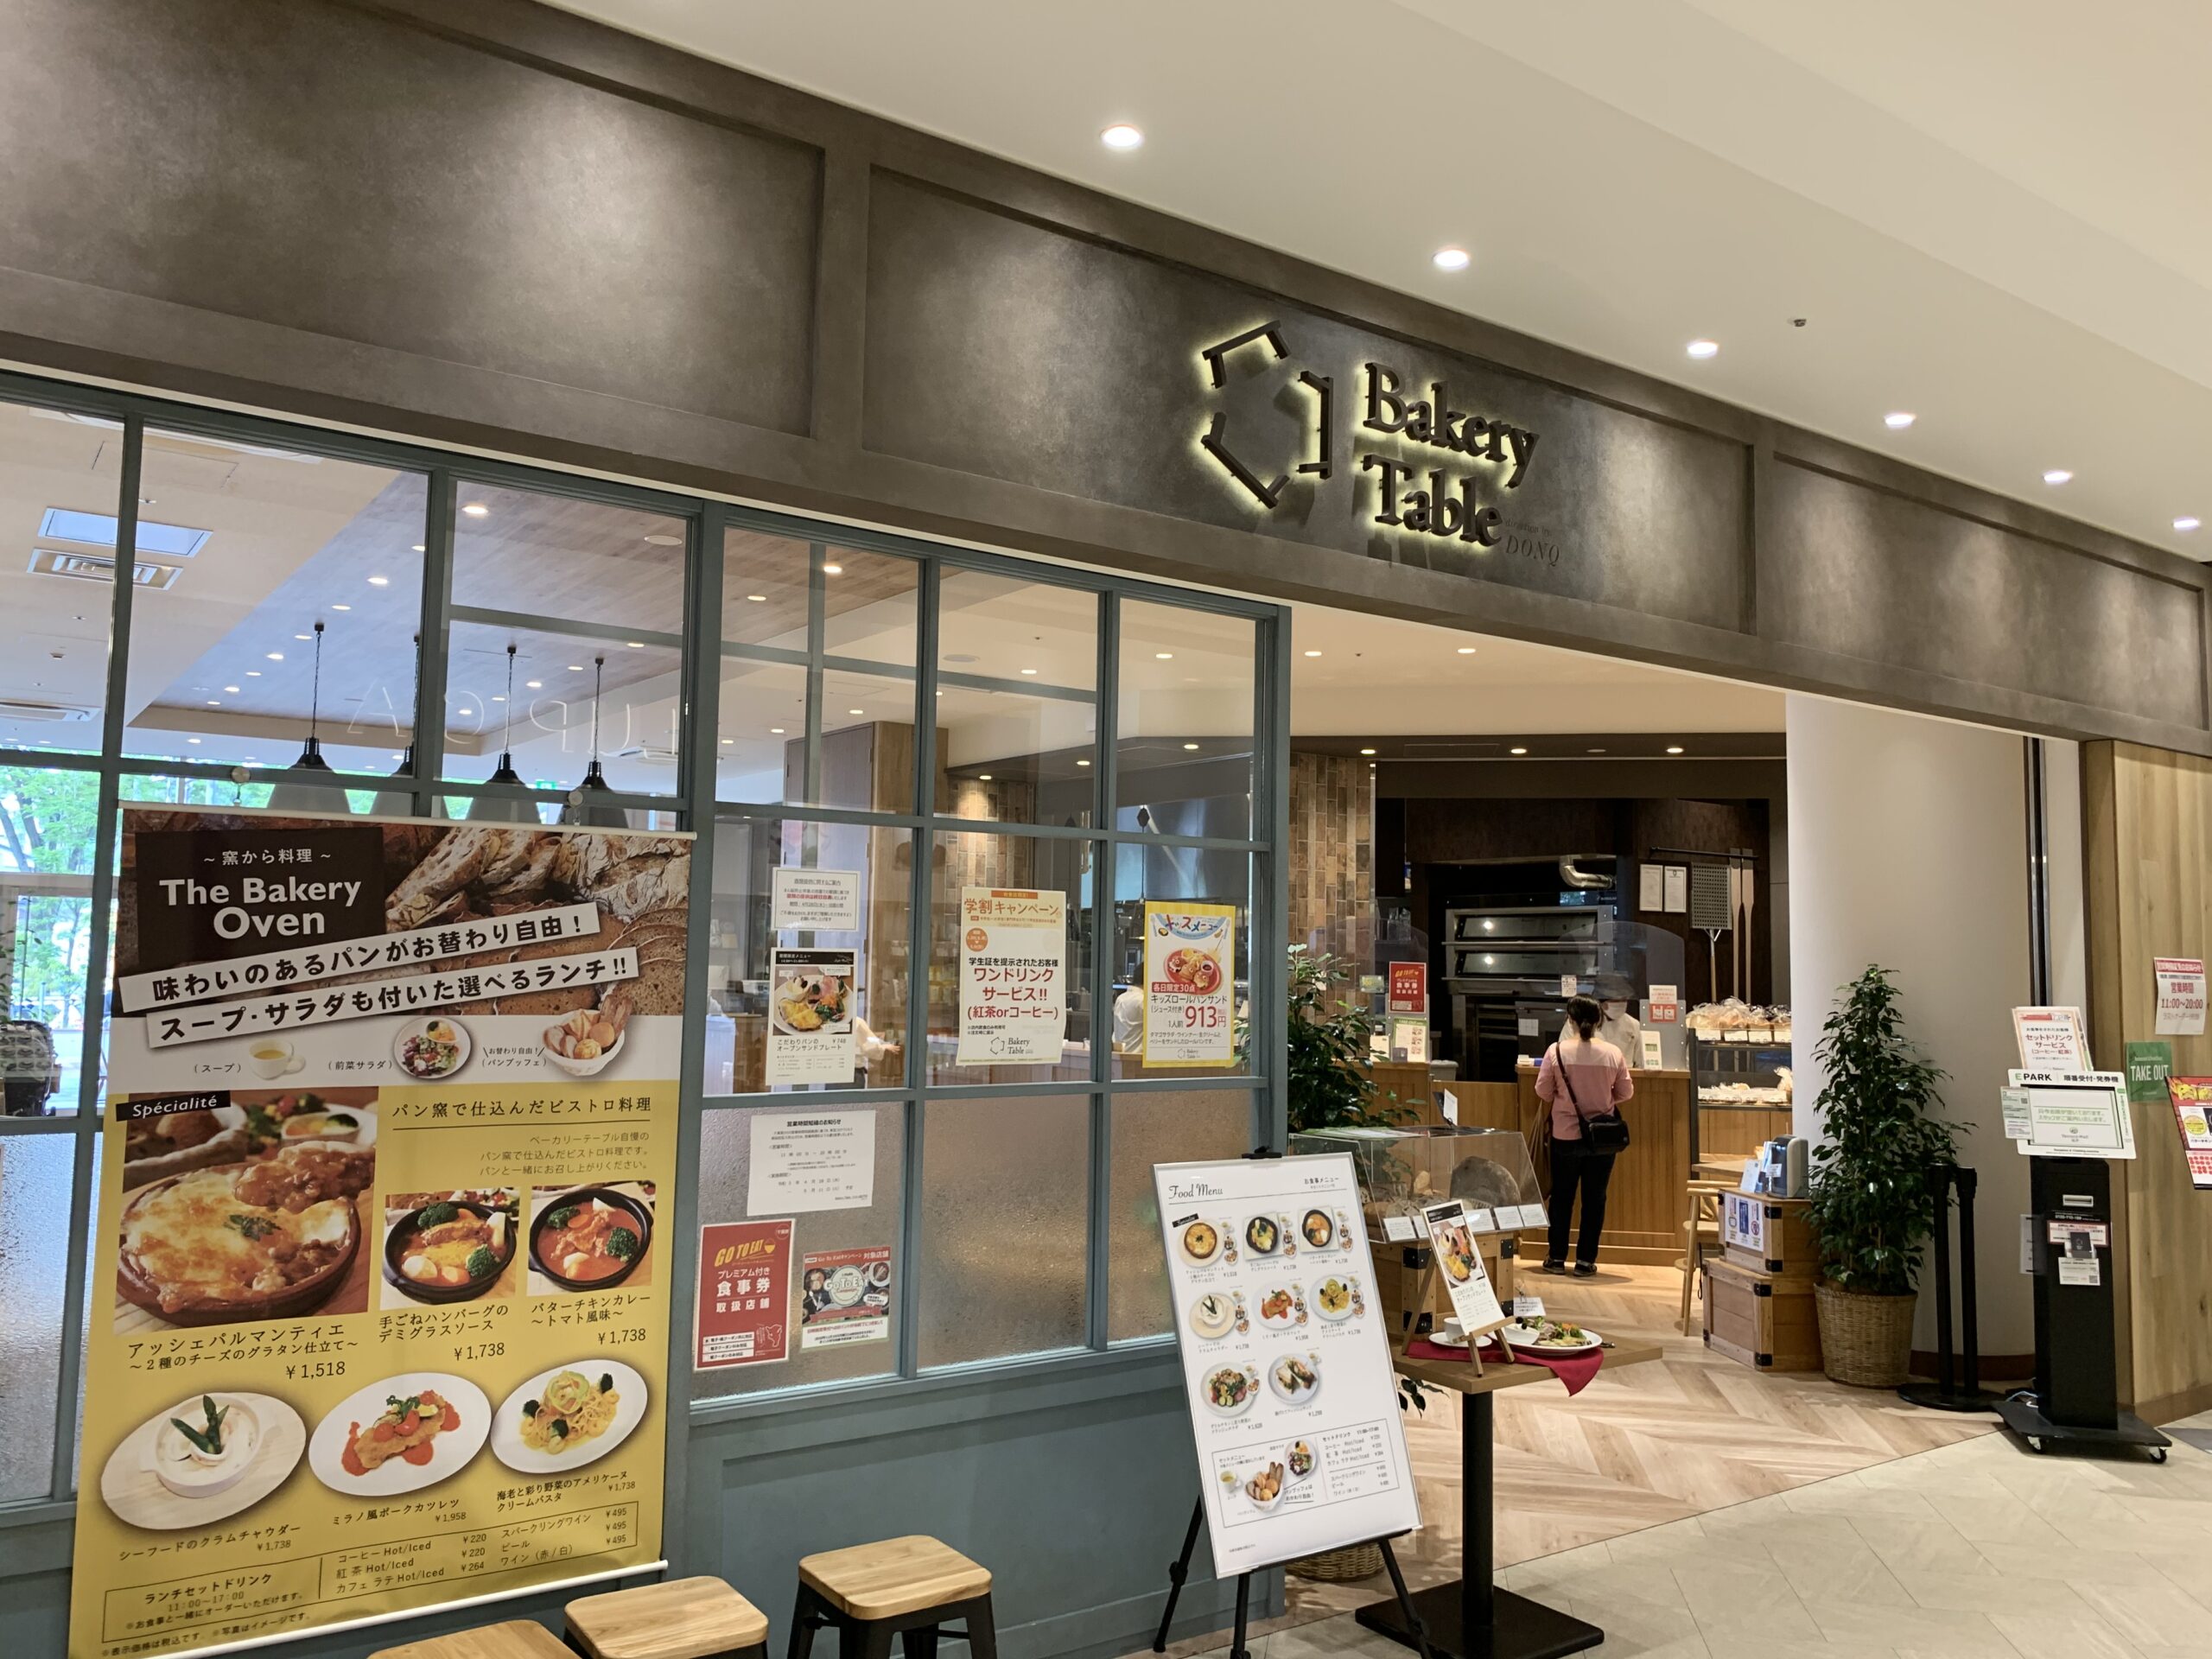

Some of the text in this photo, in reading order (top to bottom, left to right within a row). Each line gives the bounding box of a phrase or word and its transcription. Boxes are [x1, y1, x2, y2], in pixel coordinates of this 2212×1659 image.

[1363, 362, 1539, 488] Bakery
[1360, 454, 1503, 548] Table
[1506, 536, 1560, 567] DONQ
[159, 875, 362, 907] The Bakery
[963, 898, 1059, 916] 学割キャンペーン
[213, 906, 325, 939] Oven
[152, 914, 582, 1002] 味わいのあるパンがお替わり自由！
[968, 957, 1058, 967] 学生証を提示されたお客様
[974, 968, 1053, 982] ワンドリンク
[982, 986, 1047, 1001] サービス!!
[2171, 982, 2195, 994] 営業時間
[968, 1006, 1058, 1020] (紅茶orコーヒー)
[1185, 1006, 1217, 1028] 913
[1217, 1015, 1227, 1027] 円
[2130, 1065, 2169, 1082] TAKE OUT
[132, 1095, 218, 1119] Spécialité
[392, 1096, 652, 1118] パン窯で仕込んだビストロ料理
[529, 1132, 650, 1146] ベーカリーテーブル自慢の
[1167, 1183, 1224, 1199] Food Menu
[714, 1238, 765, 1268] GO TO EAT
[717, 1267, 770, 1280] プレミアム付き
[716, 1277, 771, 1297] 食事券
[531, 1294, 652, 1314] バターチキンカレー
[378, 1304, 509, 1330] 手ごねハンバーグの
[378, 1319, 494, 1344] デミグラスソース
[598, 1328, 646, 1345] ¥1,738
[454, 1342, 505, 1362] ¥1,738
[286, 1361, 346, 1380] ¥1,518
[607, 1481, 636, 1492] ¥1,738
[332, 1497, 461, 1526] ミラノ風ポークカツレツ
[497, 1492, 563, 1513] クリームパスタ
[435, 1511, 467, 1523] ¥1,958
[501, 1508, 627, 1539] スパークリングワイン ¥495
[118, 1524, 302, 1561] シーフードのクラムチャウダー
[257, 1539, 291, 1552] ¥1,738
[501, 1521, 627, 1553] ビール ¥495
[606, 1535, 627, 1545] ¥495
[338, 1533, 487, 1563] コーヒー Hot/Iced ¥220
[365, 1557, 415, 1573] Hot/Iced
[461, 1547, 486, 1558] ¥220
[397, 1567, 445, 1583] Hot/Iced
[461, 1561, 485, 1573] ¥264
[144, 1573, 272, 1605] ランチセットドリンク
